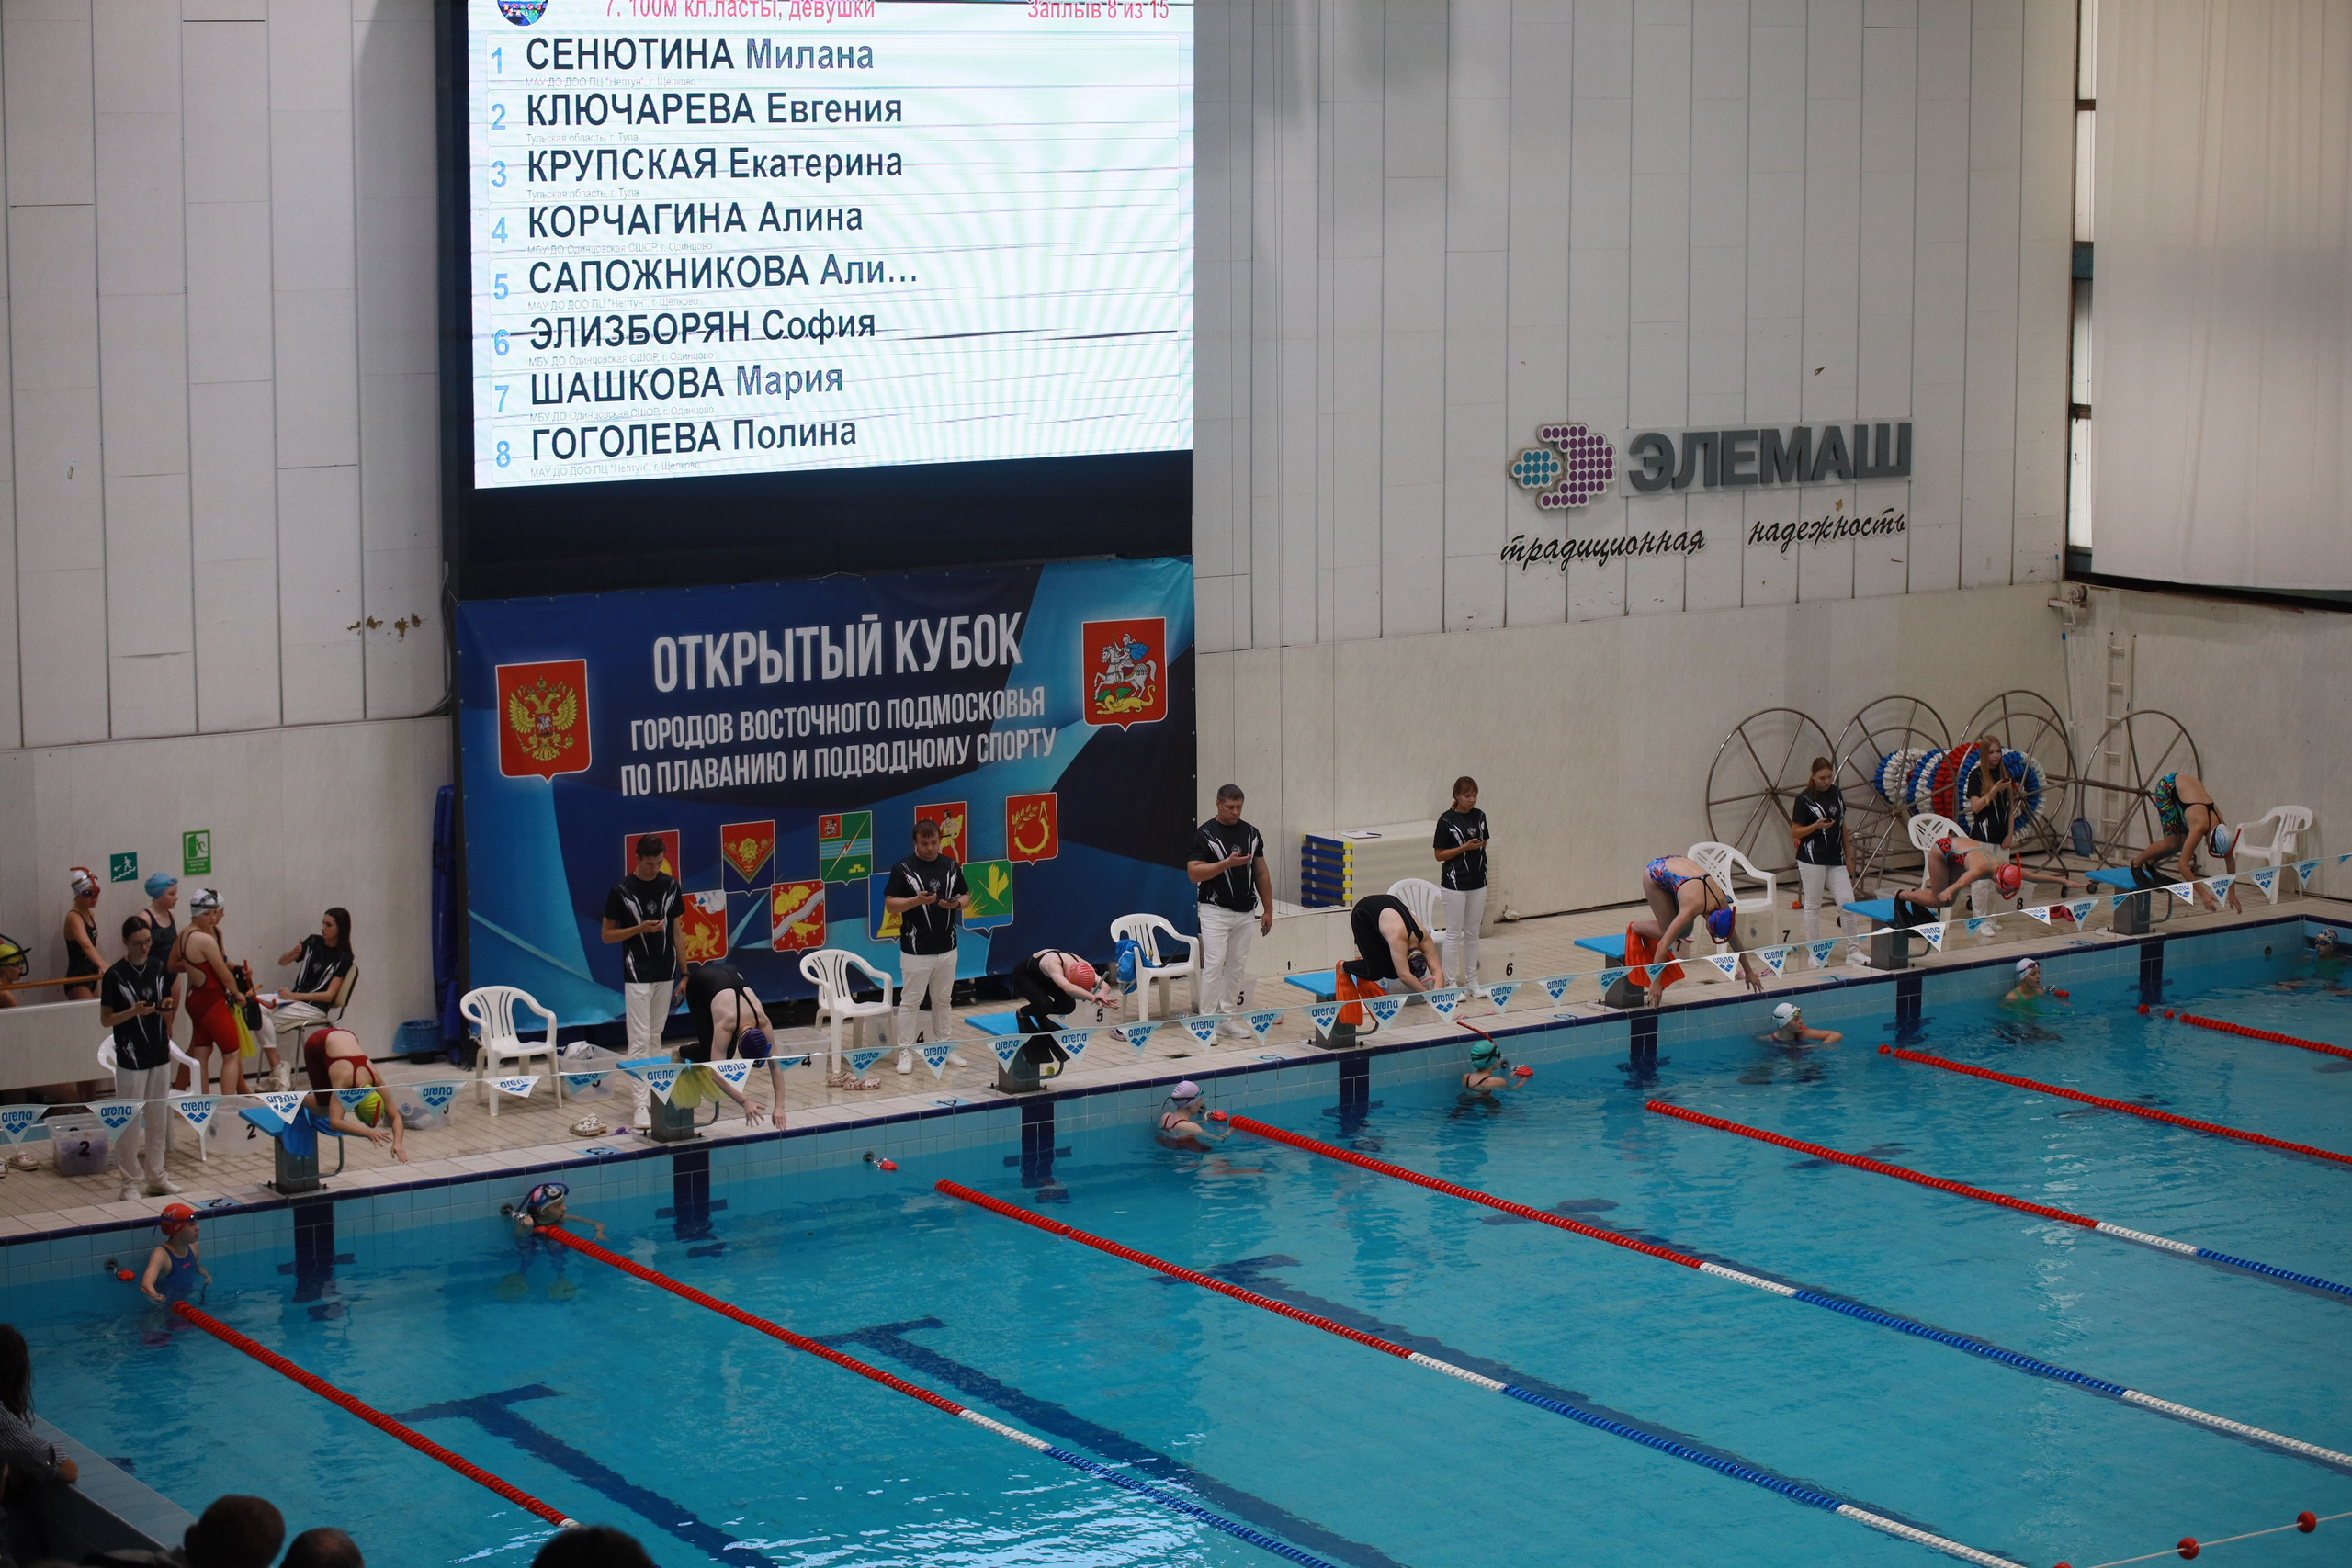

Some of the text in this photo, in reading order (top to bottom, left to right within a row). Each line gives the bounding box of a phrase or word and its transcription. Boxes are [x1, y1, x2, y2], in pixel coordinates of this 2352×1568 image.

[788, 0, 875, 24] девушки
[1027, 0, 1169, 18] Заплыв 8 из 15
[492, 37, 874, 74] 1 СЕНЮТИНА Милана
[491, 92, 902, 130] 2 КЛЮЧАРЕВА Евгения
[492, 147, 902, 188] 3 КРУПСКАЯ Екатерина
[492, 201, 864, 243] 4 КОРЧАГИНА Алина
[493, 254, 918, 300] 5 САПОЖНИКОВА Али...
[493, 308, 876, 355] 6 ЭЛИЗБОРЯН София
[495, 364, 843, 412] 7 ШАШКОВА Мария
[496, 419, 857, 468] 8 ГОГОЛЕВА Полина
[1628, 422, 1913, 491] ЭЛЕМАШ
[1499, 508, 1907, 571] традиционная надежность
[653, 612, 1023, 693] ОТКРЫТЫЙ КУБОК
[630, 685, 1046, 751] ГОРОДОВ ВОСТОЧНОГО ПОДМОСКОВЬЯ
[620, 728, 1057, 797] ПО ПЛАВАНИЮ И ПОДВОДНОМУ СПОРТУ
[2017, 897, 2024, 910] 8
[2074, 903, 2091, 913] arena
[1782, 930, 1791, 942] 7
[1813, 942, 1833, 953] arena
[1764, 950, 1784, 960] arena
[1506, 963, 1513, 976] 6
[1547, 978, 1567, 989] arena
[1490, 986, 1512, 997] arena
[1237, 991, 1245, 1005] 5
[1431, 993, 1455, 1003] arena
[1373, 999, 1399, 1010] arena
[1096, 1008, 1103, 1022] 5
[1311, 1006, 1336, 1017] arena
[1251, 1012, 1274, 1024] arena
[1128, 1026, 1151, 1037] arena
[1190, 1020, 1215, 1031] arena
[916, 1031, 924, 1043] 4
[1061, 1032, 1087, 1043] arena
[995, 1039, 1021, 1050] arena
[853, 1051, 879, 1062] arena
[923, 1046, 949, 1056] arena
[801, 1053, 811, 1067] 4
[718, 1061, 747, 1073] arena
[647, 1069, 674, 1080] arena
[423, 1086, 453, 1097] arena
[266, 1094, 299, 1103] arena
[101, 1105, 132, 1117] arena
[181, 1100, 211, 1111] arena
[2, 1111, 34, 1122] arena
[246, 1123, 256, 1140] 2
[78, 1141, 90, 1157] 2
